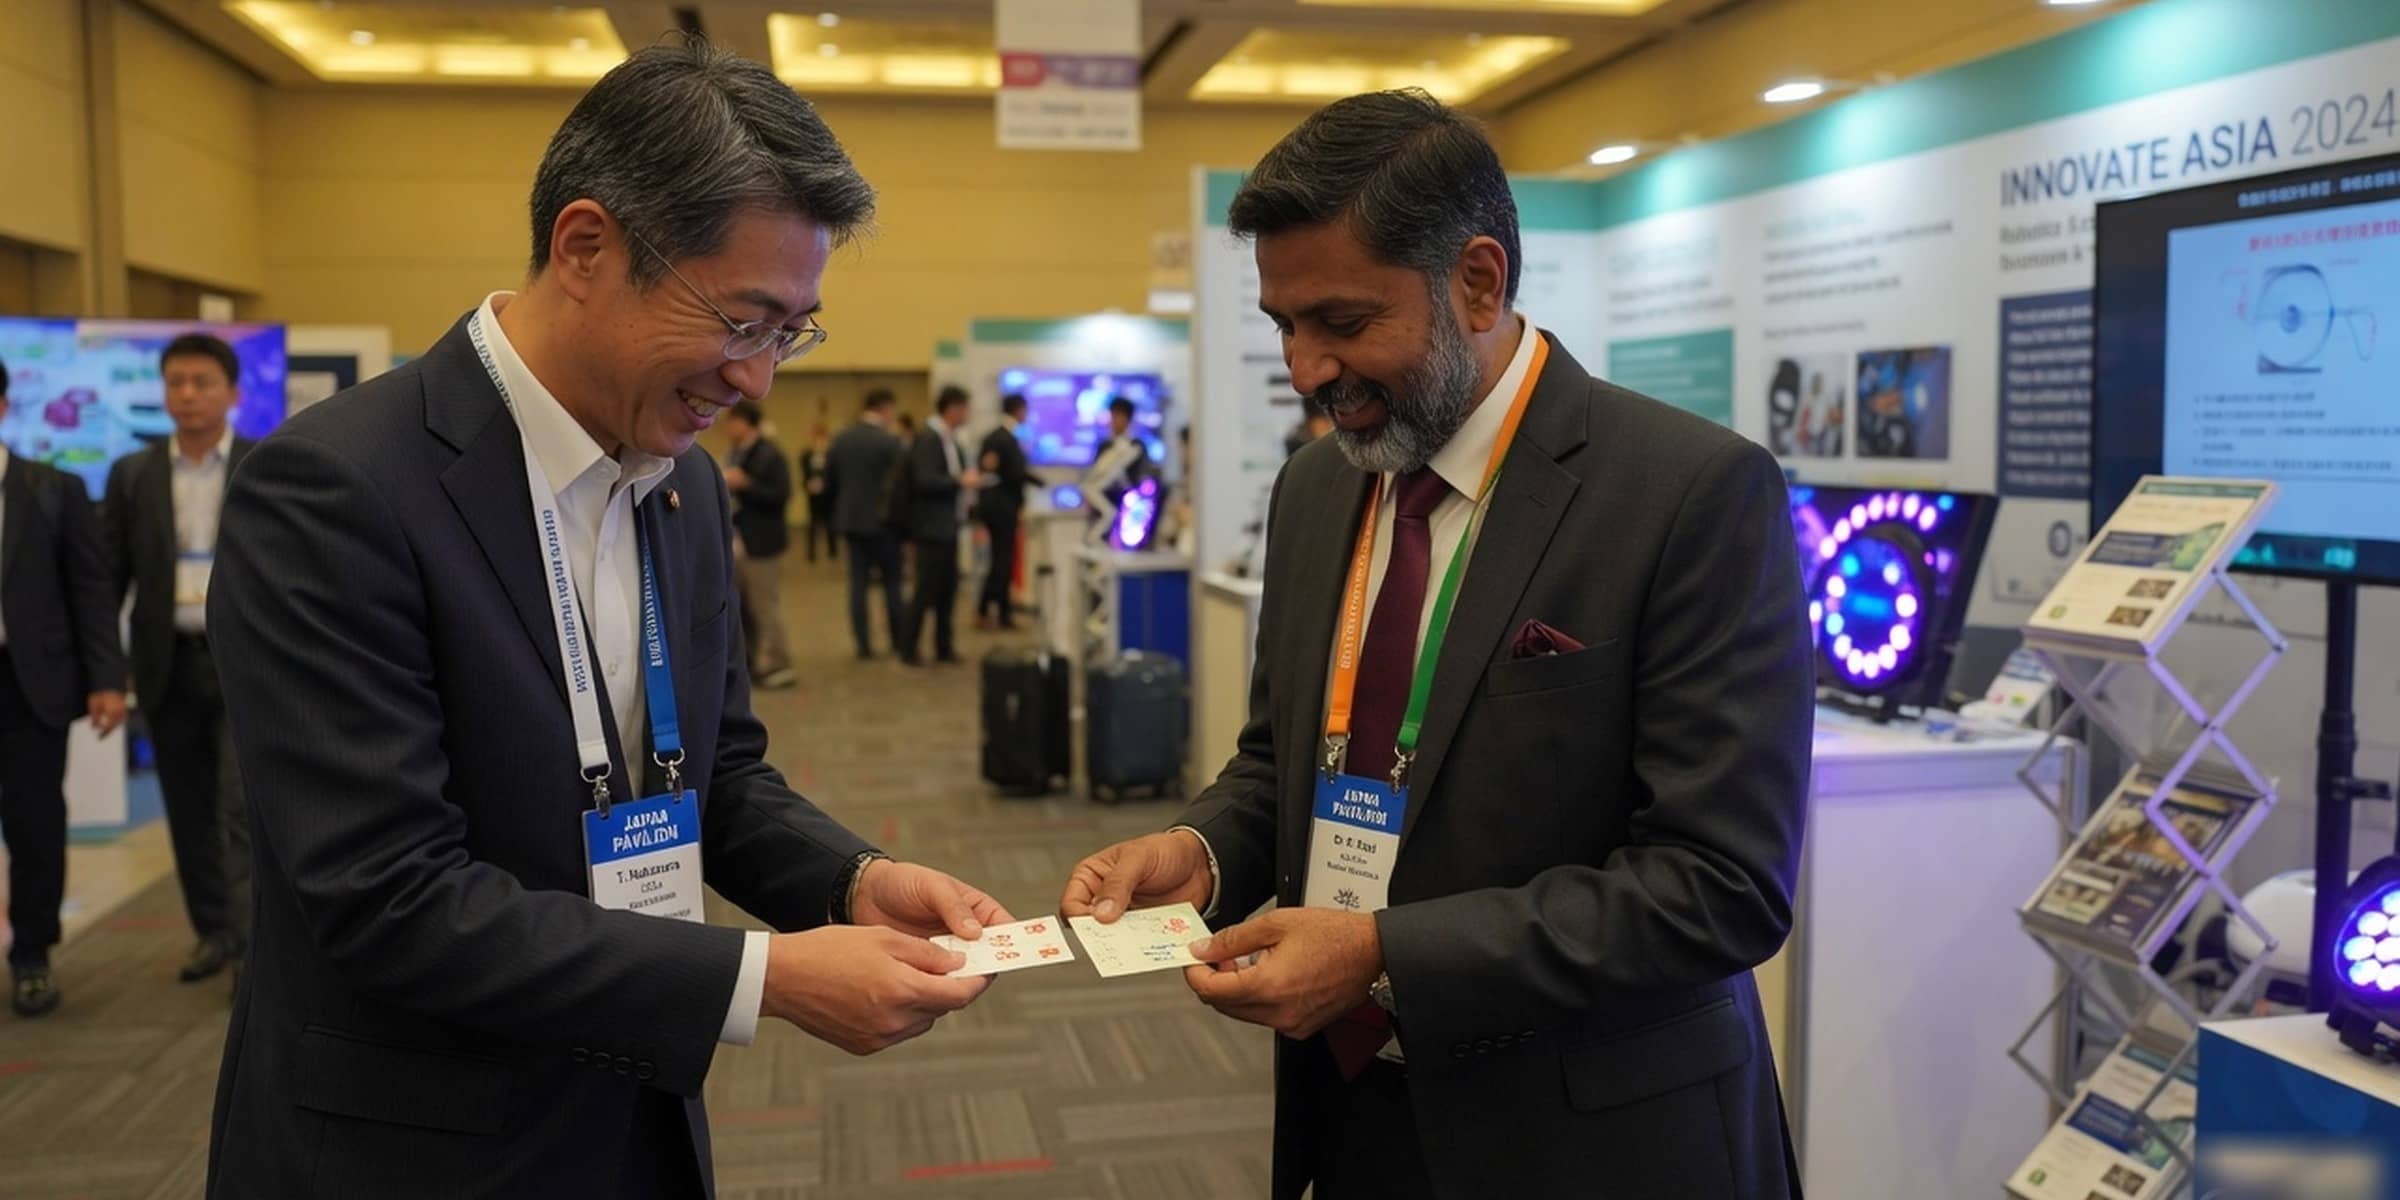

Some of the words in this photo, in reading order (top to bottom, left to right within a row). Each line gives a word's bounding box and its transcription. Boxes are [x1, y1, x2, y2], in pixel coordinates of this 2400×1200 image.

[2000, 137, 2170, 208] INNOVATE
[2181, 115, 2278, 175] ASIA
[2290, 87, 2400, 156] 2024
